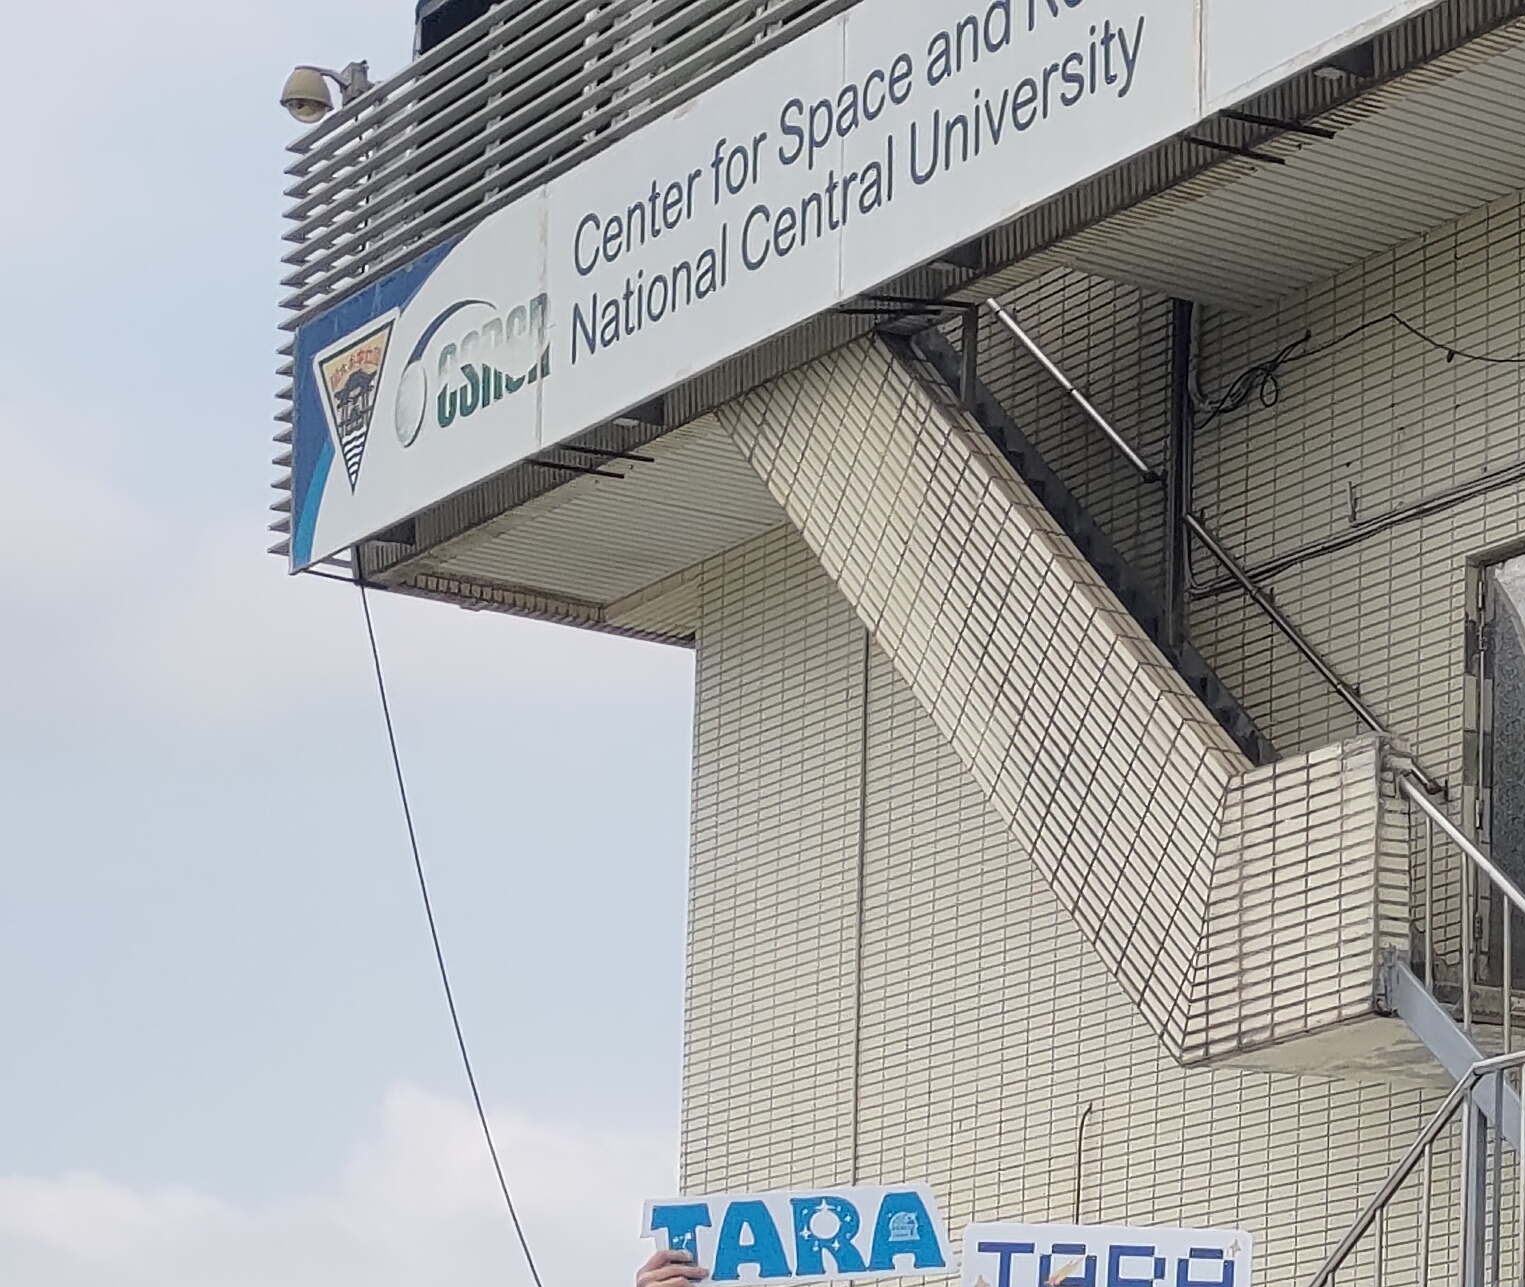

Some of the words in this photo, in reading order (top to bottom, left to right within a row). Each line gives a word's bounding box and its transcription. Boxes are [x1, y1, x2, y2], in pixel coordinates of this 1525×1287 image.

[571, 222, 728, 365] National
[742, 134, 893, 271] Central
[910, 15, 1145, 185] University
[574, 168, 702, 276] Center
[711, 131, 768, 206] for
[778, 52, 913, 171] Space
[926, 0, 1011, 87] and
[650, 1191, 949, 1281] TARA
